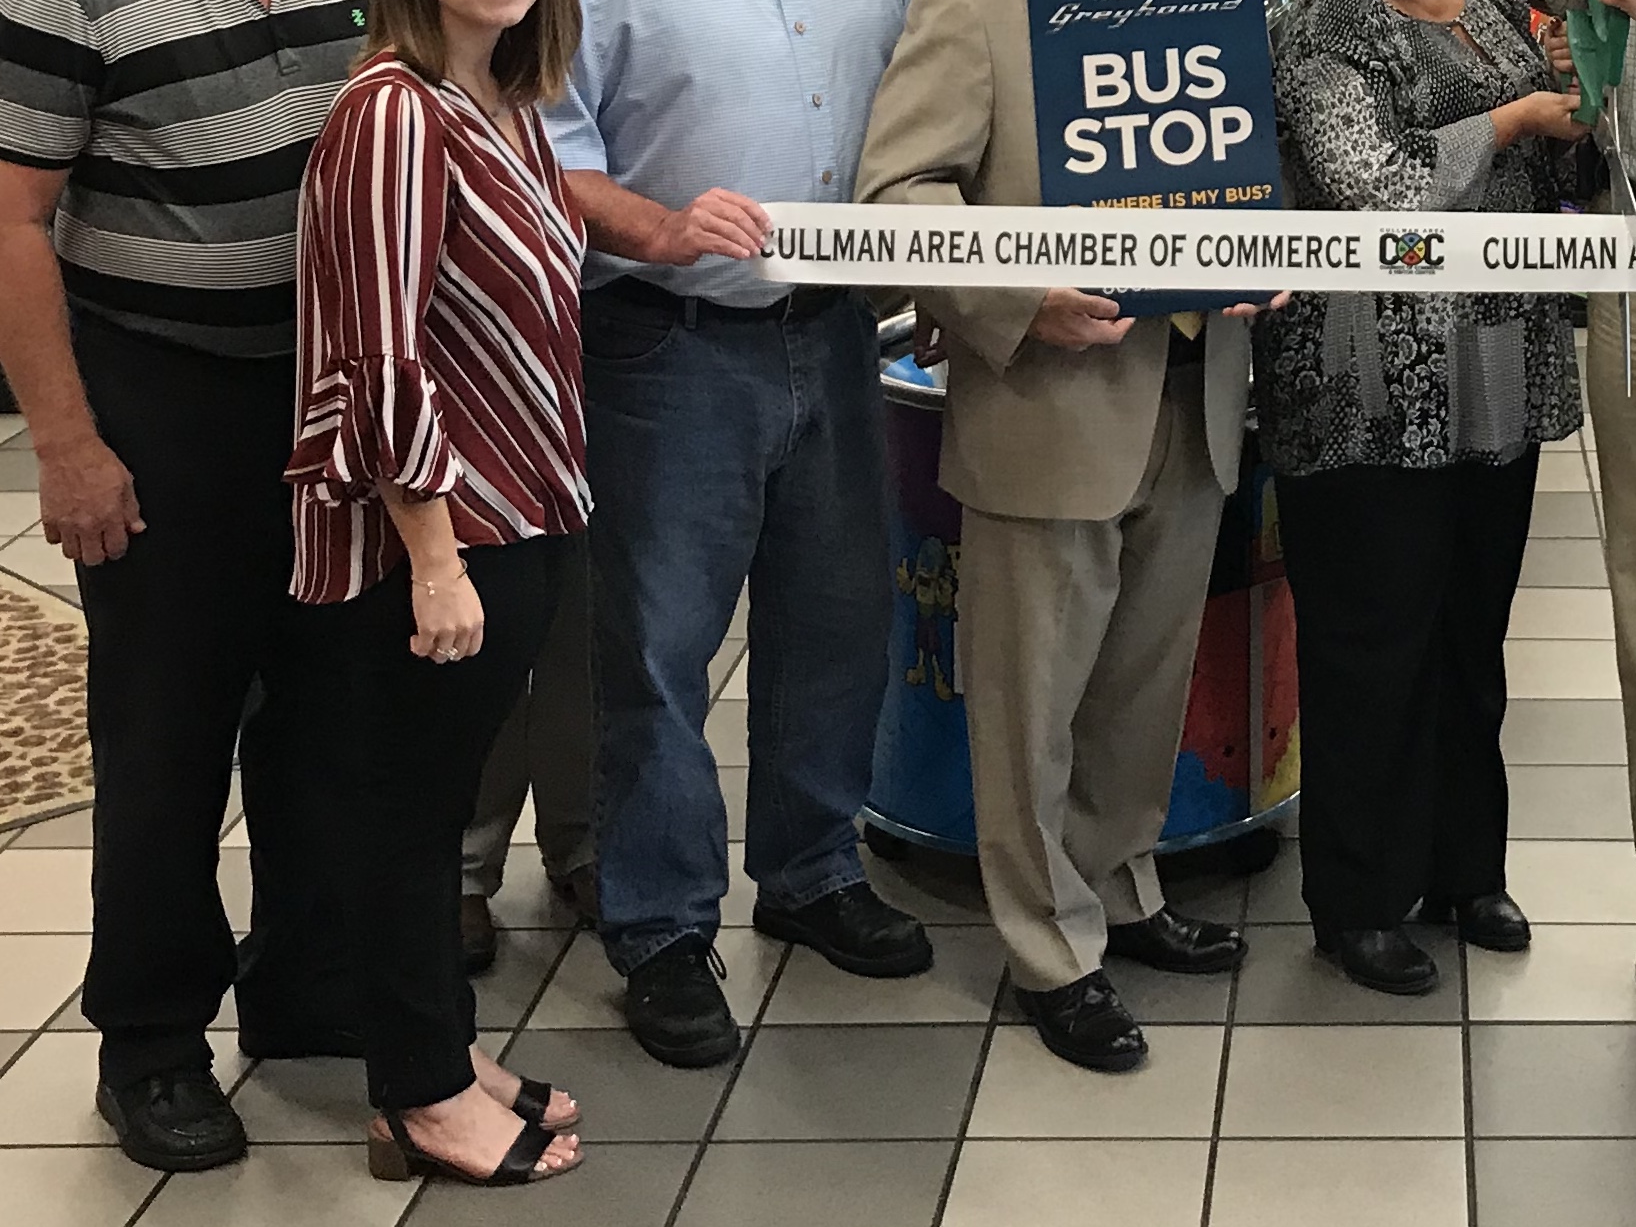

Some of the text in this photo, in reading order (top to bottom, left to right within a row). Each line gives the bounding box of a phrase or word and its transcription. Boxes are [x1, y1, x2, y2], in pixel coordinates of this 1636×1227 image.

[1083, 45, 1227, 109] BUS
[1064, 106, 1253, 174] STOP
[1169, 193, 1186, 207] IS
[1191, 189, 1220, 206] MY
[1225, 184, 1273, 203] BUS?
[760, 228, 1362, 269] CULLMAN AREA CHAMBER OF COMMERCE
[1482, 236, 1617, 270] CULLMAN
